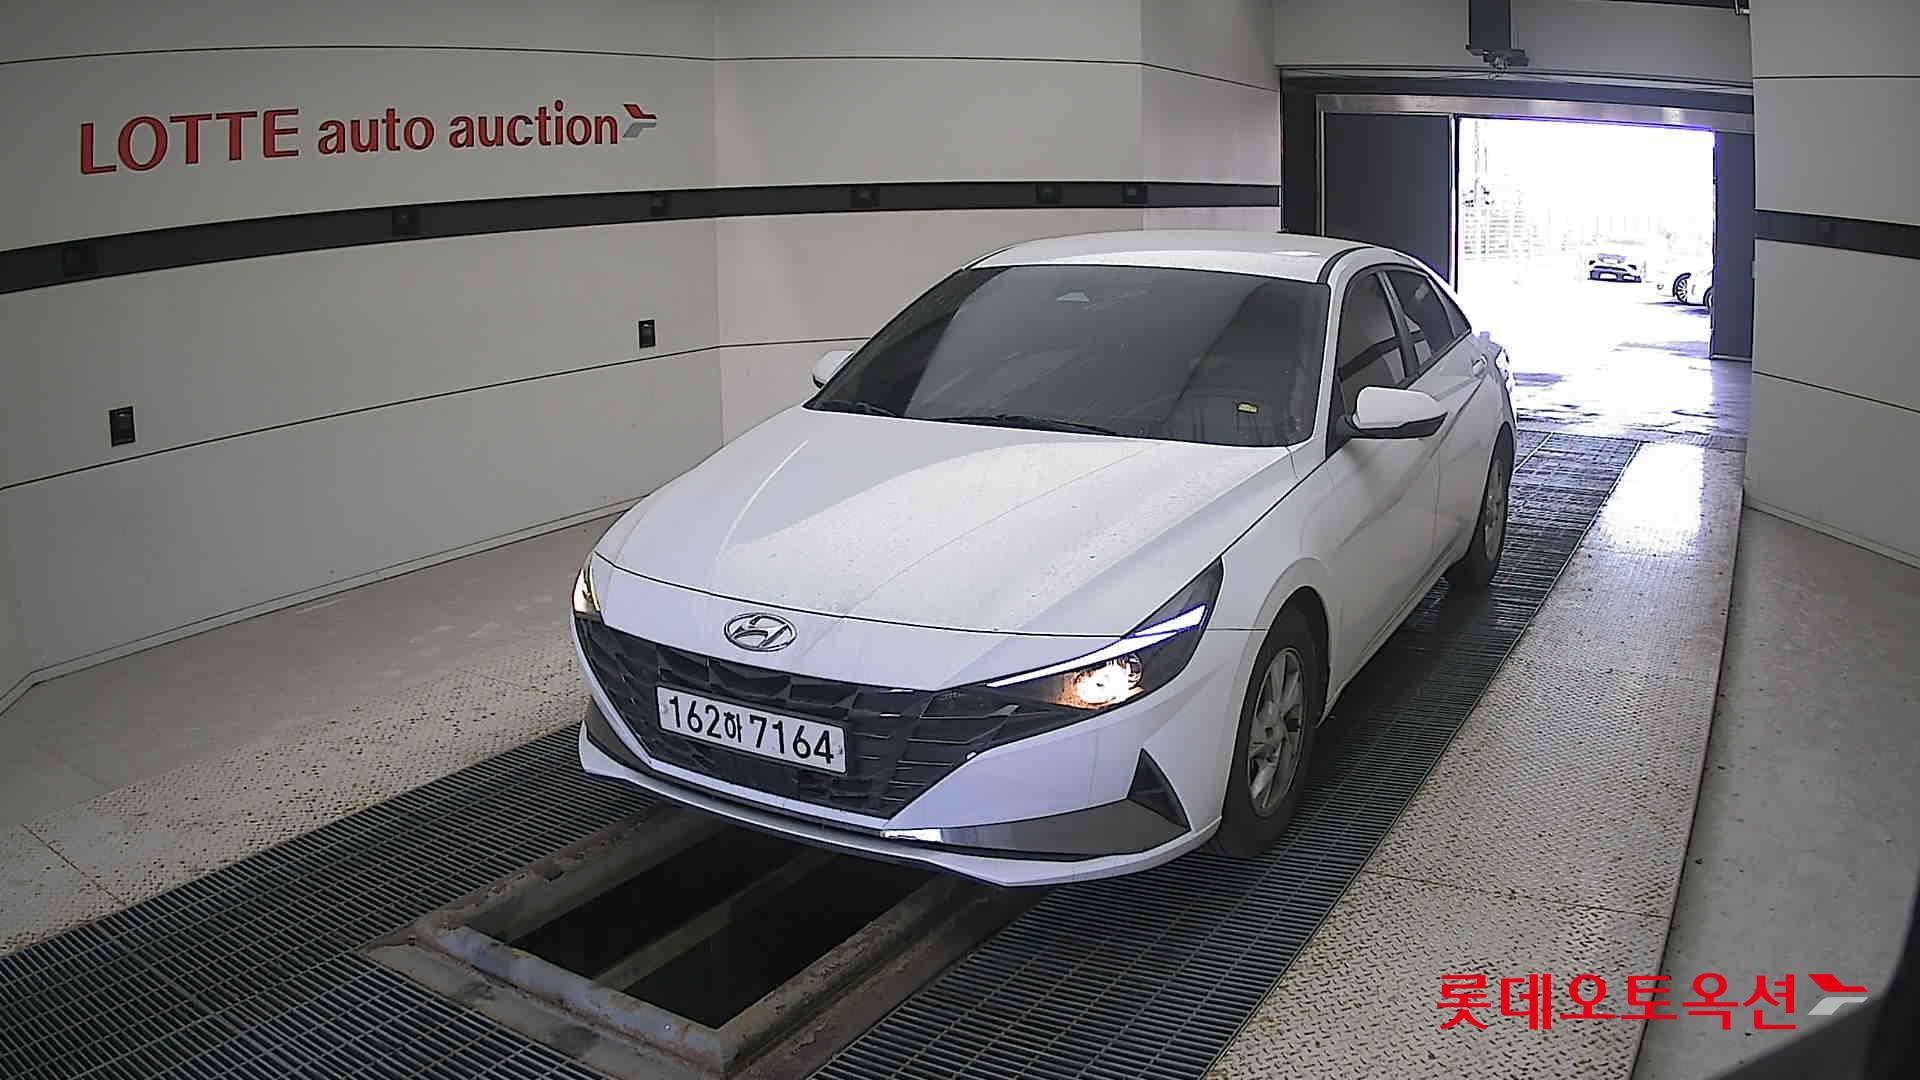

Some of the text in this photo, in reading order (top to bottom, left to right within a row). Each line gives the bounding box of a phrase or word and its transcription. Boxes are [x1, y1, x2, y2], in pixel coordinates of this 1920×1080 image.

[80, 100, 619, 174] LOTTE auto auction
